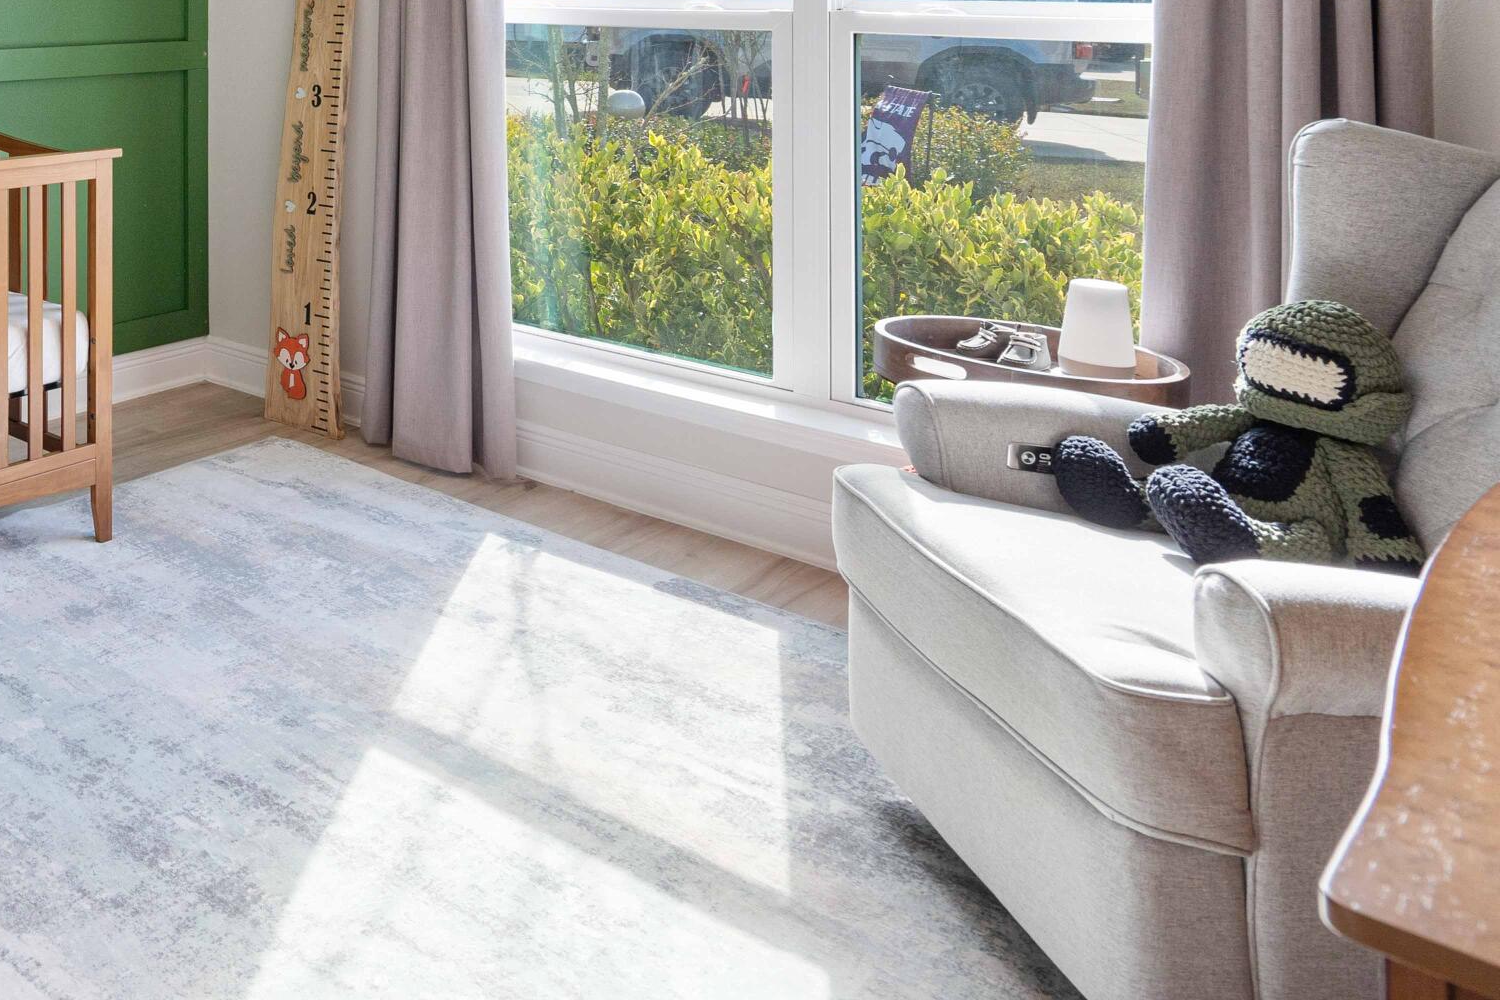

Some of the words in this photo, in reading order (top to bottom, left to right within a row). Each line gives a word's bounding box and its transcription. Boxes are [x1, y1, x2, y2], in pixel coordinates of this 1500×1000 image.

[311, 84, 323, 108] 3
[306, 191, 317, 215] 2
[304, 302, 312, 325] 1
